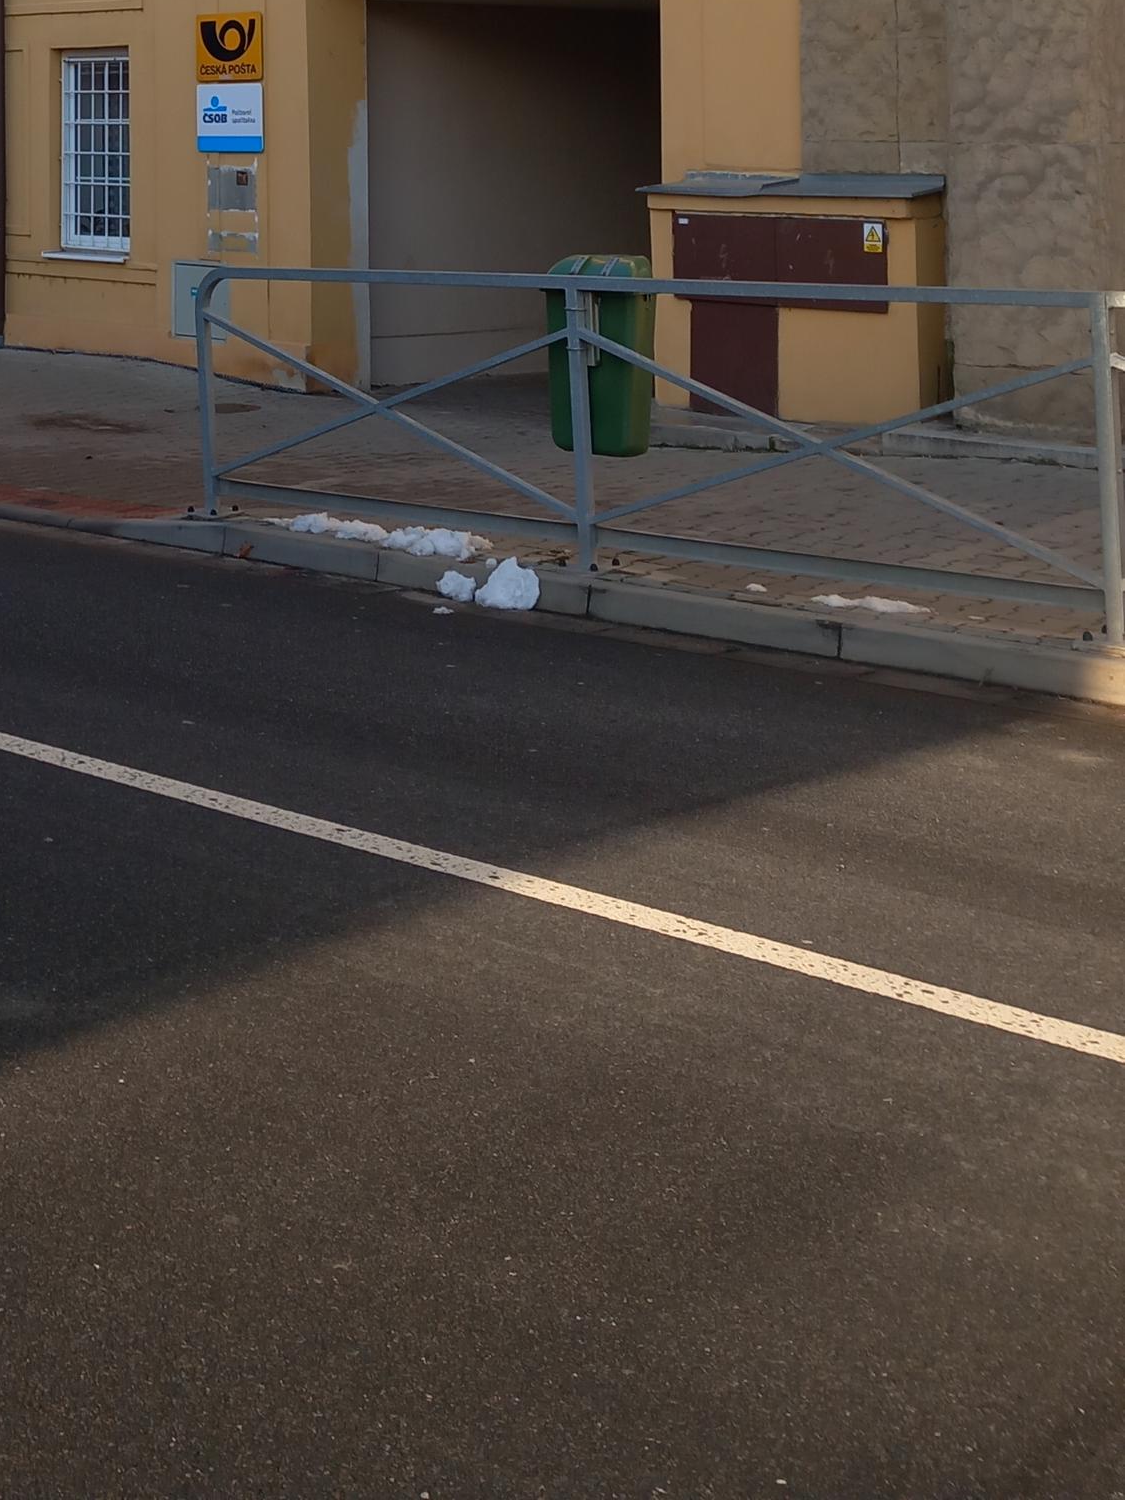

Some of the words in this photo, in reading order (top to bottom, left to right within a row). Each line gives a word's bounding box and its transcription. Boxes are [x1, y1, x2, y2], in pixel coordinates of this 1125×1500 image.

[200, 64, 227, 76] ČESKÁ
[228, 62, 257, 74] POŠTA
[203, 112, 228, 124] ČSOB
